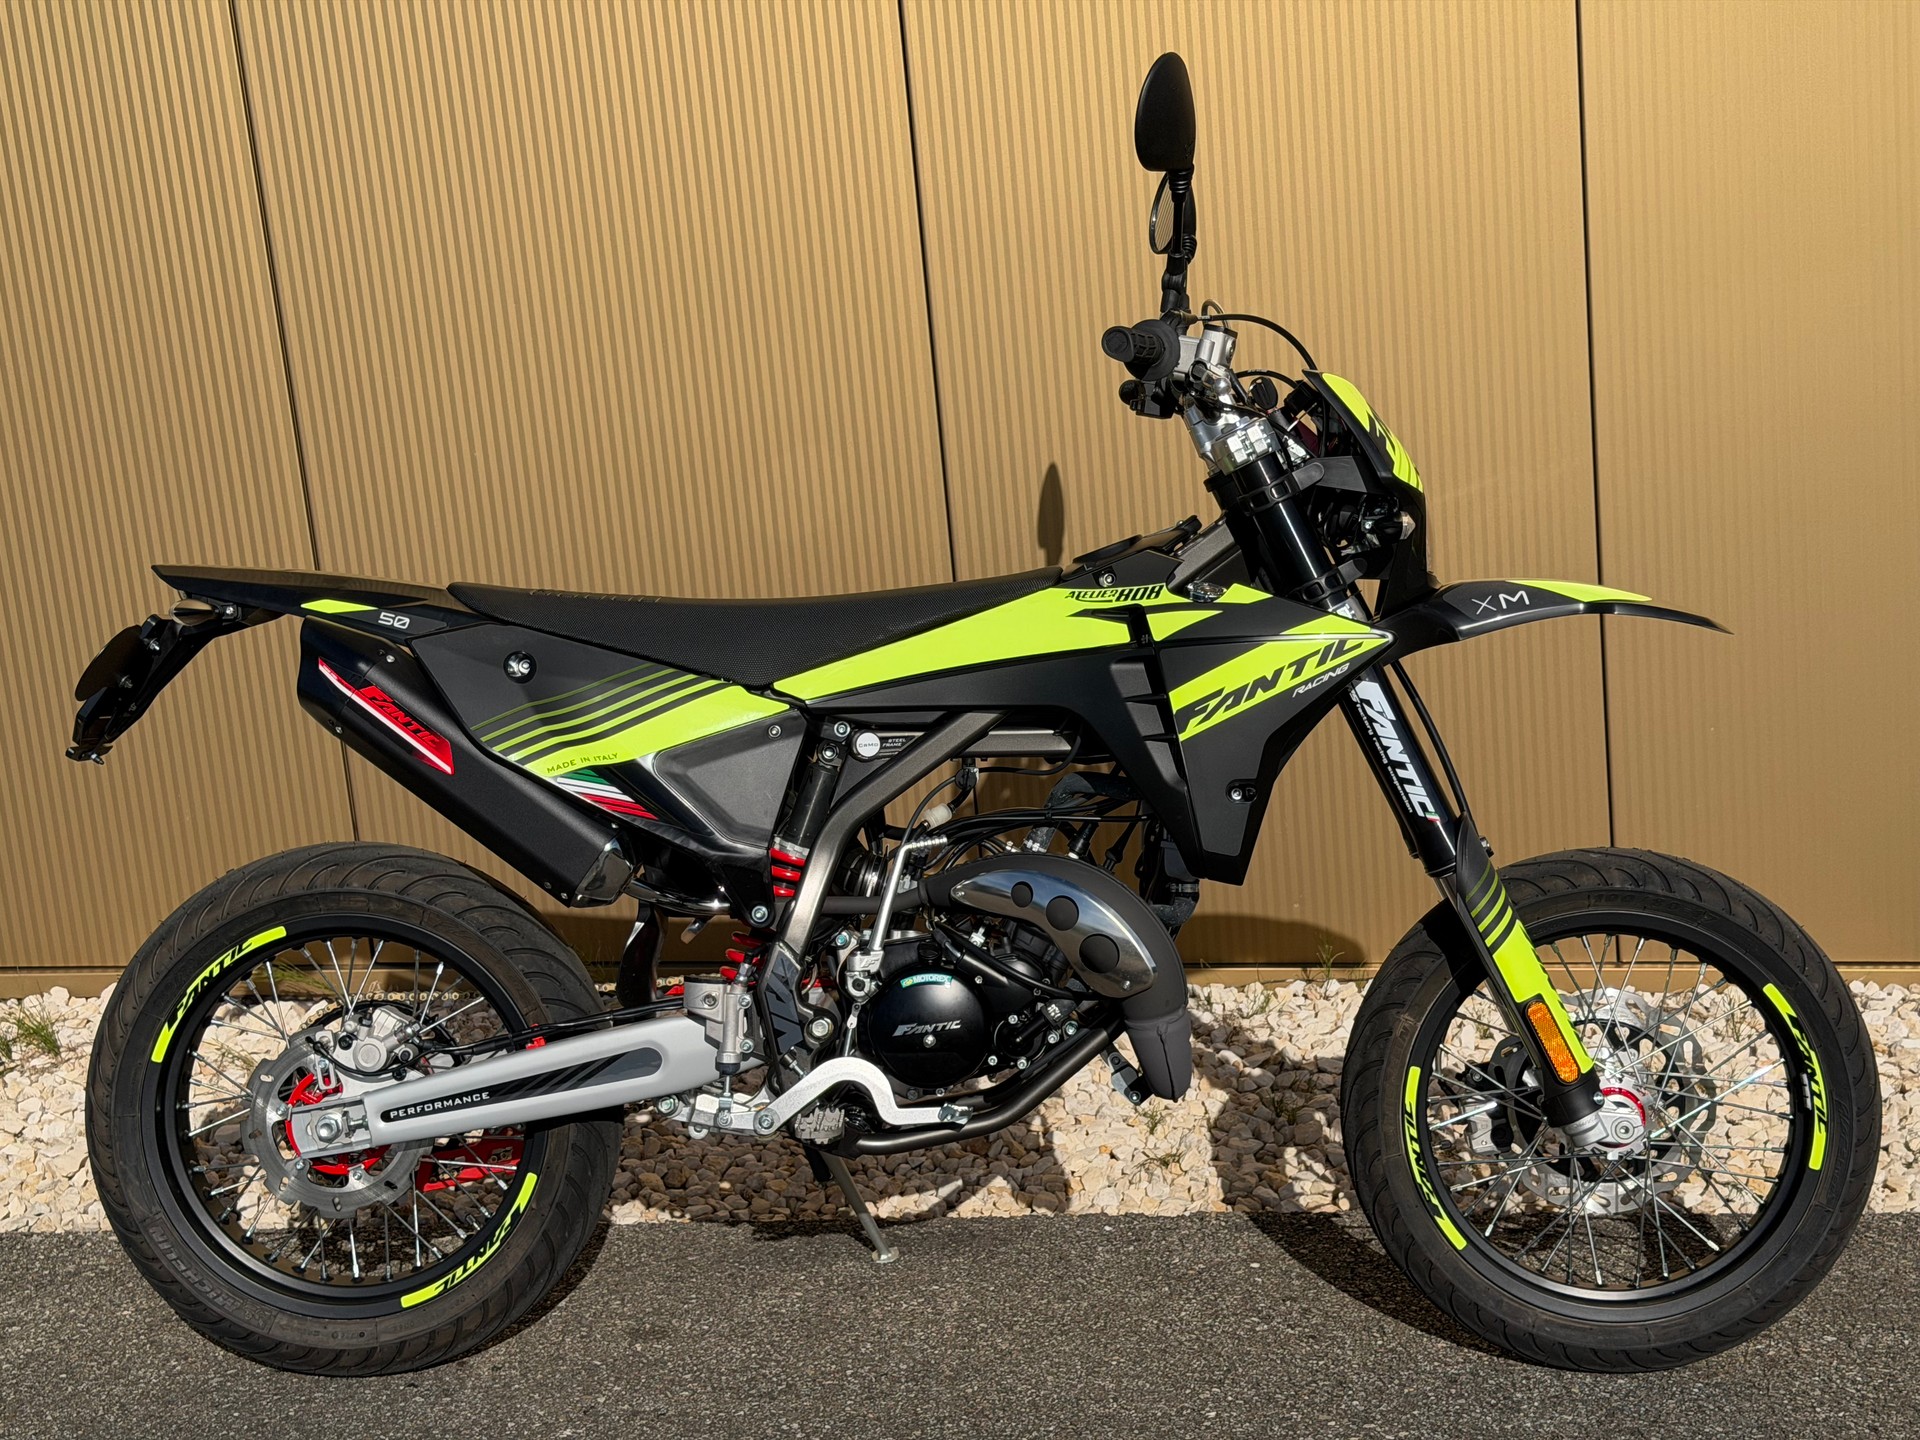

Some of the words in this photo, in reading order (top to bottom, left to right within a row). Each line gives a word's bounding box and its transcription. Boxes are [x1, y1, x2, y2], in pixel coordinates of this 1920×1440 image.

[1064, 589, 1118, 603] ATELIER
[1115, 584, 1165, 602] 808
[1471, 590, 1530, 615] XM
[378, 611, 410, 629] 50
[1174, 640, 1365, 735] FANTIC
[1292, 662, 1350, 698] RACING
[360, 685, 440, 748] FANTIC
[546, 759, 577, 774] MADE
[593, 753, 618, 762] ITALY
[1355, 680, 1436, 818] FANTIC
[166, 941, 254, 1032] FANTIC
[913, 974, 952, 983] MOTOREX
[892, 1019, 962, 1037] FANTIC
[1786, 1011, 1828, 1134] FANTIC
[389, 1091, 490, 1119] PERFORMANCE
[1404, 1100, 1445, 1220] FANTIC
[433, 1202, 522, 1292] FANTIC
